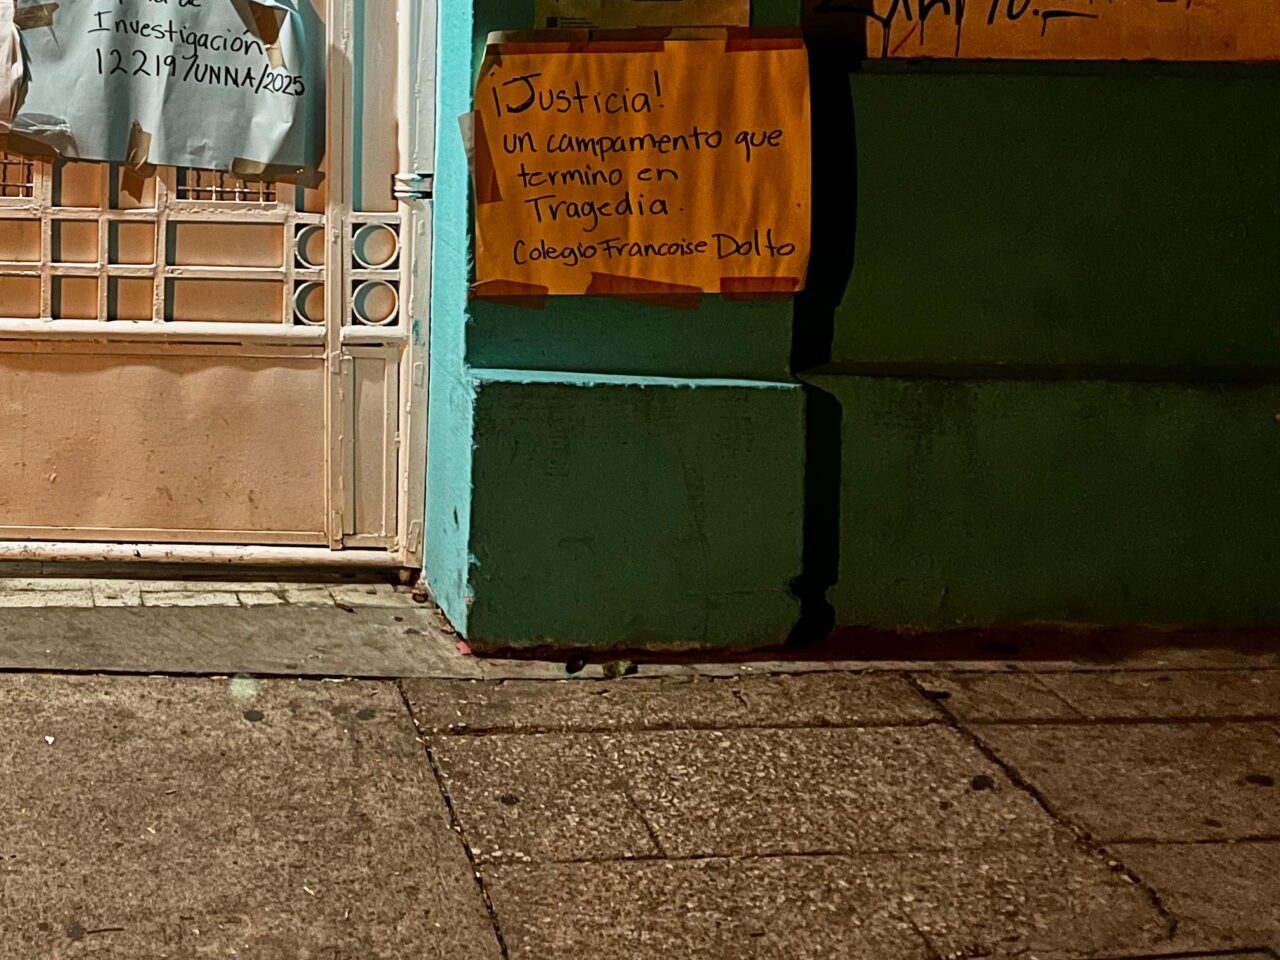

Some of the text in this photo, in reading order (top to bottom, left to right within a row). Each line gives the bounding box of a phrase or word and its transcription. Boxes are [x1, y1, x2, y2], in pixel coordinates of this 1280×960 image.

[87, 10, 264, 58] Investigación
[490, 70, 665, 118] ¡Justicia!
[503, 126, 783, 162] un campamento que
[517, 164, 678, 189] termino en
[513, 228, 796, 267] Colegio Francoise Dolto
